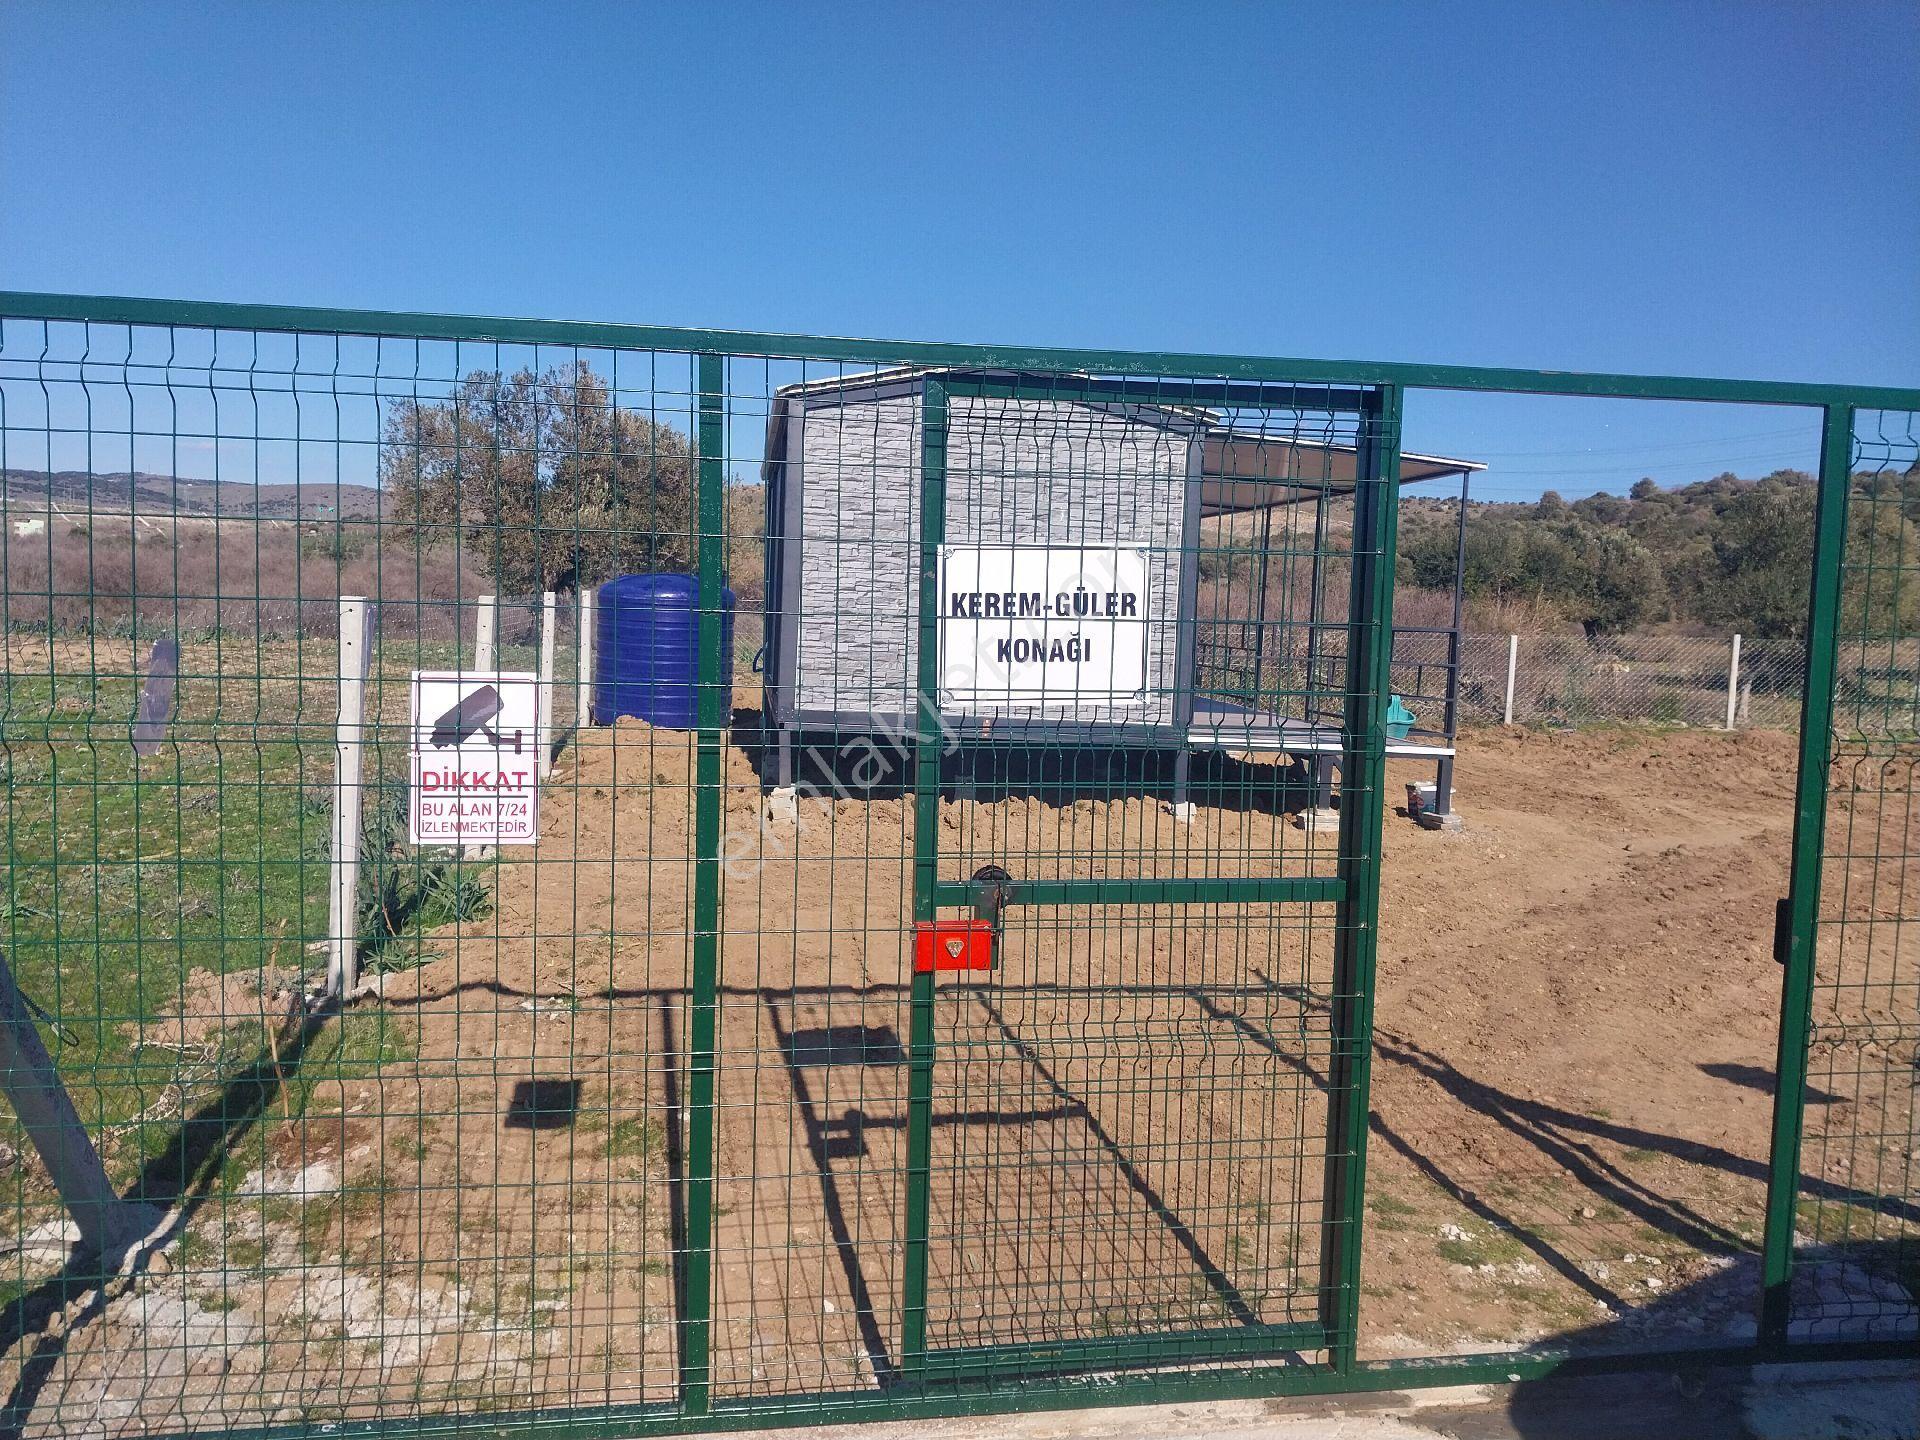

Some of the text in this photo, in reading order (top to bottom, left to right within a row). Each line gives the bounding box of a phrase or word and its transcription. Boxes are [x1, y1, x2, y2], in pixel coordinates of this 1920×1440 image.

[951, 587, 1137, 617] KEREM-GÜLER
[997, 631, 1091, 663] KONAĞI
[422, 766, 528, 792] DİKKAT
[422, 803, 527, 816] BU ALAN 7/24
[421, 820, 527, 833] İZLENMEKTEDİR
